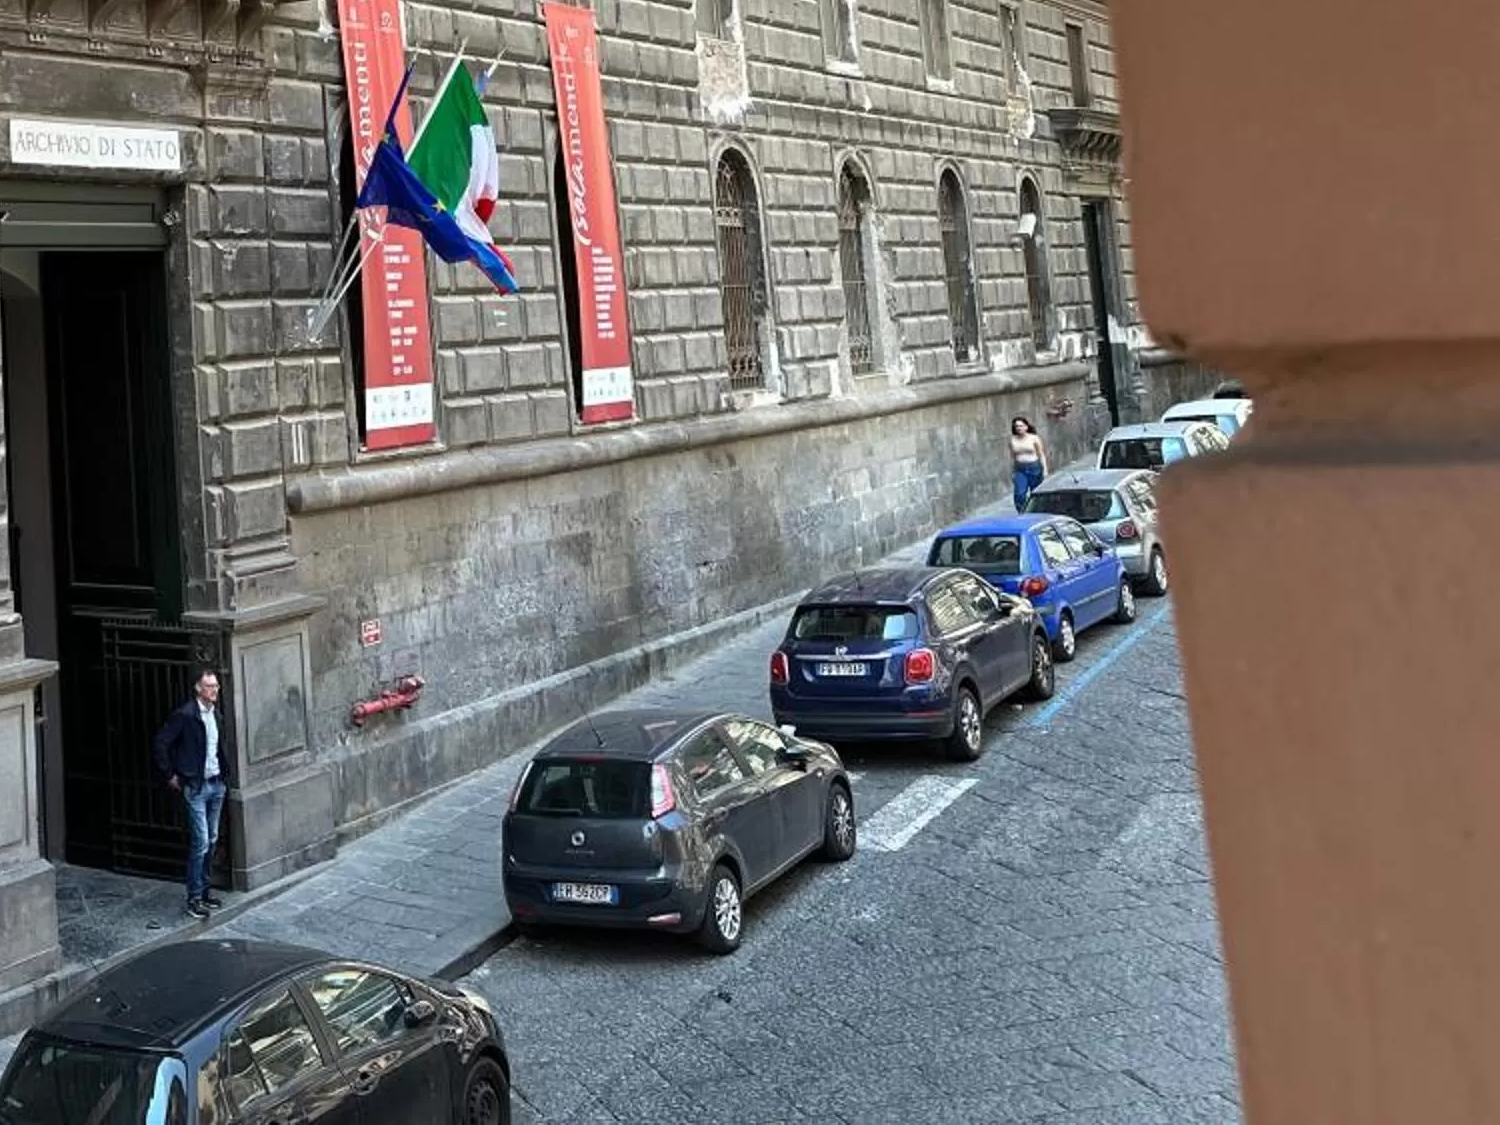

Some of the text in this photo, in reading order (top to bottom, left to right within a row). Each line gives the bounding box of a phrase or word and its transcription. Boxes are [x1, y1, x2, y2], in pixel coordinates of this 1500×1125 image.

[15, 130, 177, 160] ARCHIVIO DI STATO
